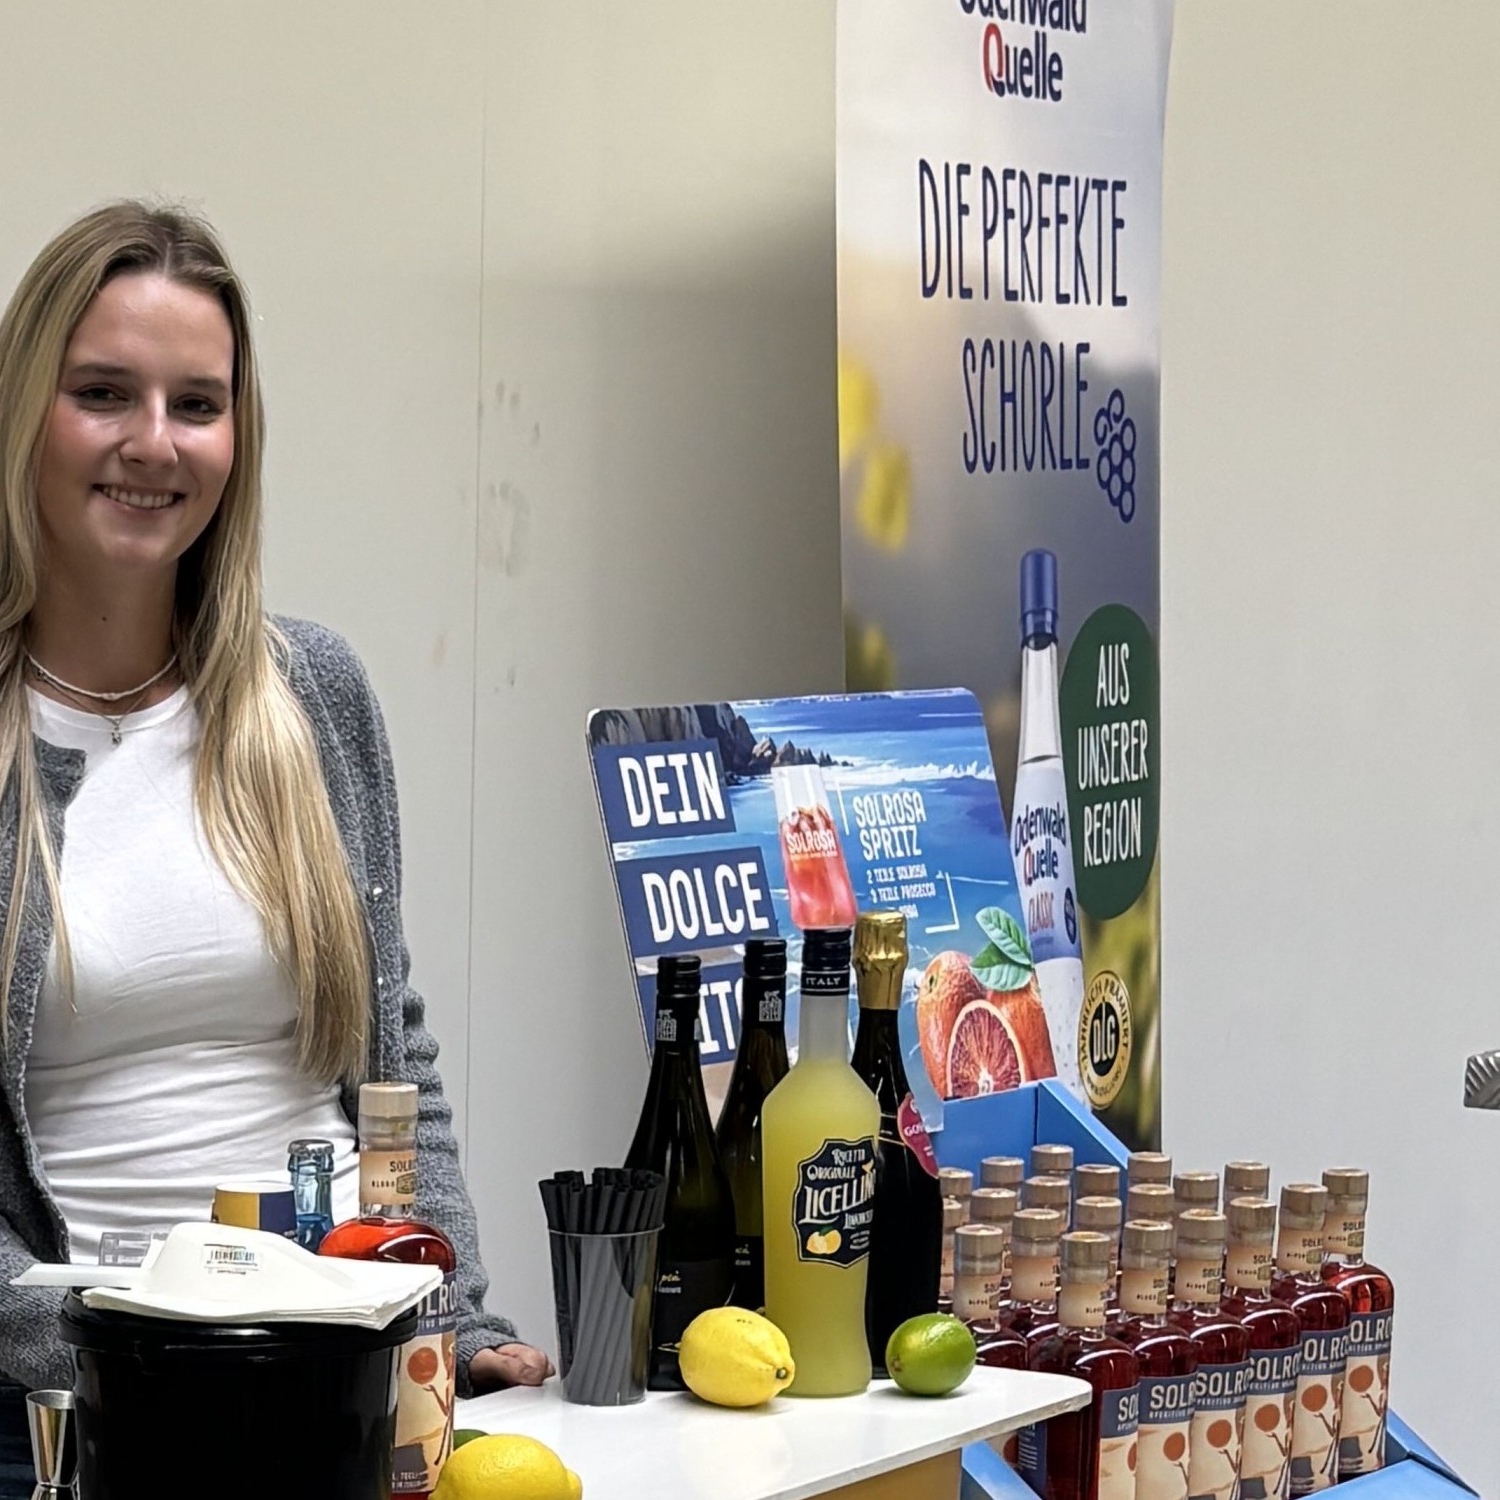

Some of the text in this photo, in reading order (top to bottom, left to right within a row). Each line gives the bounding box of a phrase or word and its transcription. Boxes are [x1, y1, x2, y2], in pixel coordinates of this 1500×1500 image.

[982, 22, 1064, 102] Quelle
[918, 157, 1128, 307] DIE PERFEKTE
[962, 337, 1091, 474] SCHORLE
[1096, 642, 1130, 709] AUS
[617, 749, 726, 828] DEIN
[1077, 718, 1149, 791] UNSERER
[785, 829, 837, 855] SOLROSA
[852, 790, 928, 828] SOLROSA
[859, 824, 923, 861] SPRITZ
[1014, 801, 1067, 857] Odenwald
[1083, 796, 1142, 868] REGION
[1023, 838, 1059, 887] Quelle
[641, 861, 770, 943] DOLCE
[805, 976, 841, 987] ITALY
[697, 978, 745, 1055] IT
[1092, 1001, 1116, 1065] DLG
